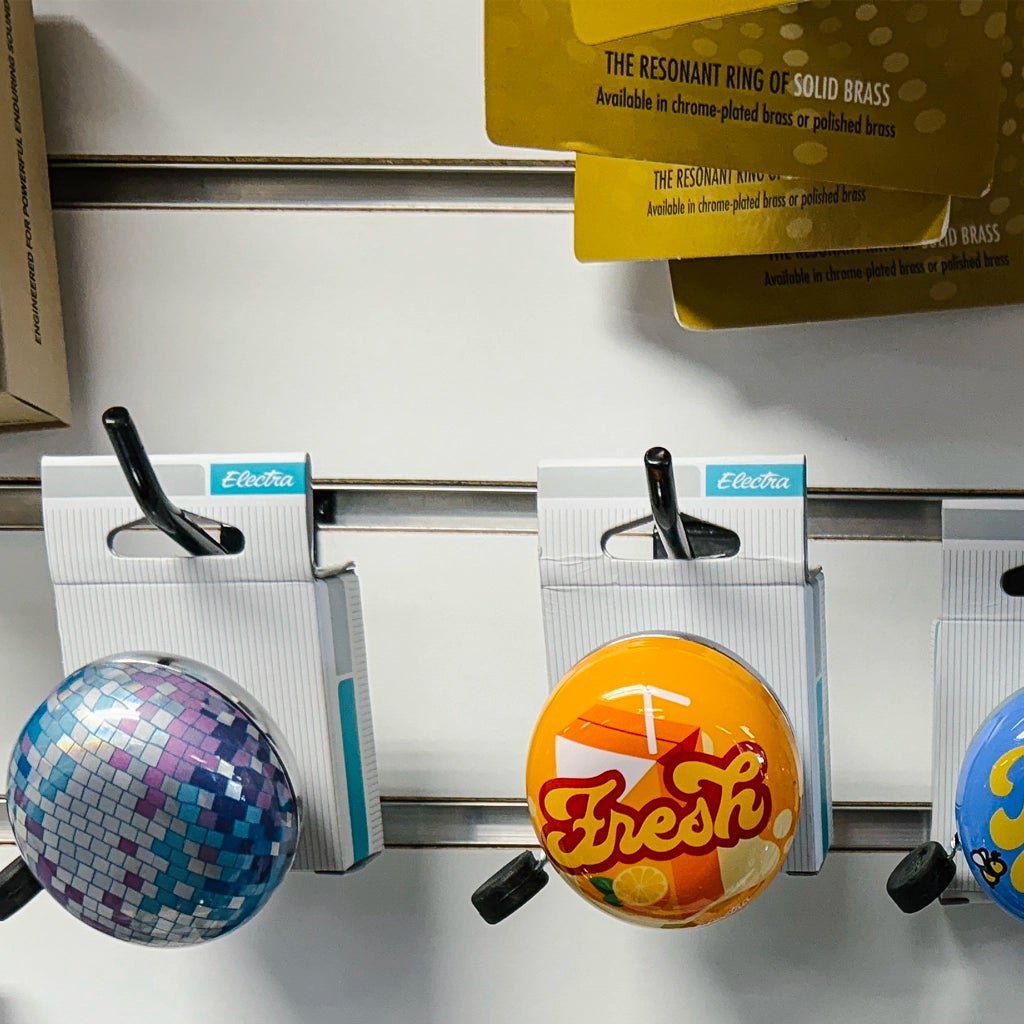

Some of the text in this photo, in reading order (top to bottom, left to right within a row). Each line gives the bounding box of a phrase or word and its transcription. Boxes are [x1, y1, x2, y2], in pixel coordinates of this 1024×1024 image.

[8, 56, 22, 134] ENDURING
[605, 51, 890, 107] THE RESONANT RING OF SOLID BRASS
[596, 86, 896, 138] Available in chrome-plated brass or polished brass
[16, 137, 30, 217] POWERFUL
[654, 170, 674, 190] THE
[676, 167, 732, 188] RESONANT
[647, 185, 866, 217] Available in chrome-plated brass or polished brass
[24, 219, 33, 249] FOR
[961, 223, 1001, 245] BRASS
[765, 270, 810, 287] Available
[813, 268, 823, 283] in
[899, 258, 925, 276] brass
[928, 261, 937, 273] or
[941, 254, 982, 274] polished
[984, 251, 1010, 268] brass
[27, 251, 42, 345] ENGINEERED
[222, 470, 296, 489] Electra
[717, 471, 792, 490] Electra
[541, 746, 769, 872] Fresh
